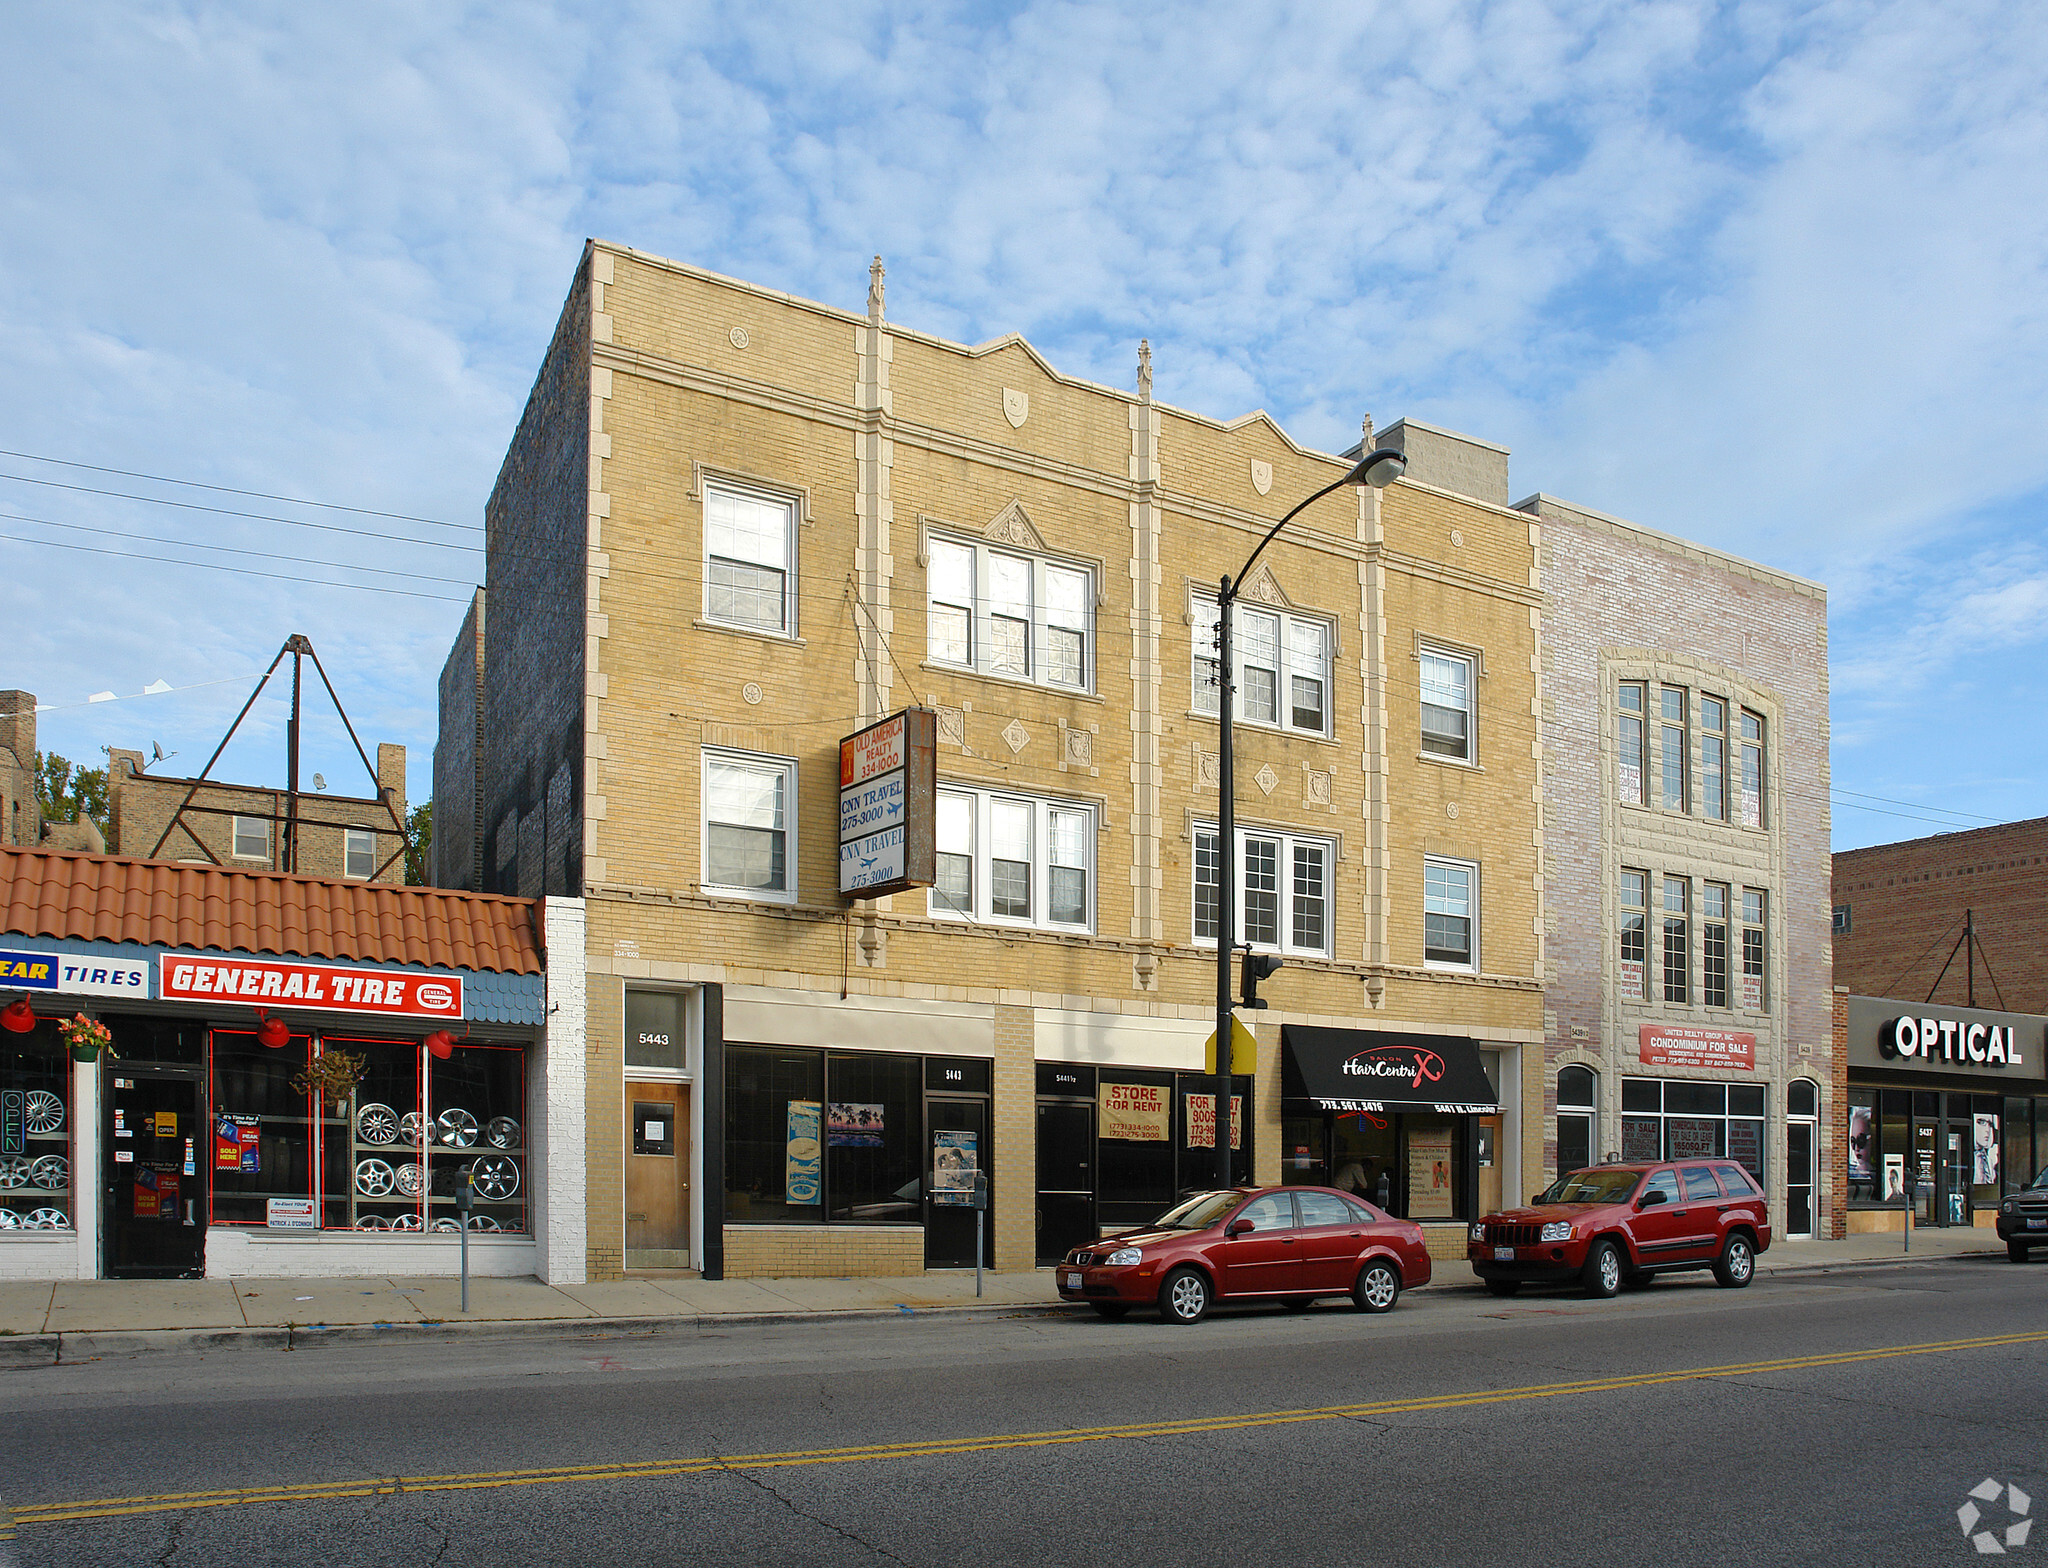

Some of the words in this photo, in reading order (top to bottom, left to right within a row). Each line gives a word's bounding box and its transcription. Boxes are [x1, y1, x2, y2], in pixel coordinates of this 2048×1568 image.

[856, 733, 870, 753] OLD
[870, 718, 903, 748] AMERICA
[866, 740, 893, 762] REALTY
[861, 751, 899, 779] 334-1000
[841, 792, 861, 815] CNN
[862, 779, 903, 807] TRAVEL
[841, 804, 884, 832] 275-3000
[840, 838, 861, 862] CNN
[864, 827, 905, 855] TRAVEL
[850, 865, 893, 889] 275-3000
[63, 966, 143, 987] TIRES
[171, 964, 324, 1000] GENERAL
[331, 975, 406, 1006] TIRE
[424, 989, 447, 997] GENERAL
[638, 1033, 669, 1046] 5443
[1664, 1028, 1683, 1037] UNITED
[1684, 1030, 1704, 1038] REALTY
[1895, 1015, 2023, 1065] OPTICAL
[1650, 1037, 1707, 1051] CONDOMINIUM
[1709, 1042, 1726, 1052] FOR
[1728, 1043, 1748, 1054] SALE
[945, 1069, 962, 1081] 5443
[1111, 1086, 1158, 1101] STORE
[1190, 1095, 1210, 1109] FOR
[1105, 1099, 1129, 1111] FOR
[1132, 1101, 1163, 1113] RENT
[5, 1093, 20, 1151] OPEN
[1621, 1121, 1635, 1132] FOR
[1638, 1122, 1657, 1133] SALE
[1698, 1121, 1714, 1132] CONDO
[1670, 1131, 1680, 1140] FOR
[1681, 1131, 1692, 1140] SALE
[1692, 1131, 1699, 1140] OR
[1700, 1131, 1713, 1142] LEASE
[1918, 1127, 1934, 1137] 5437
